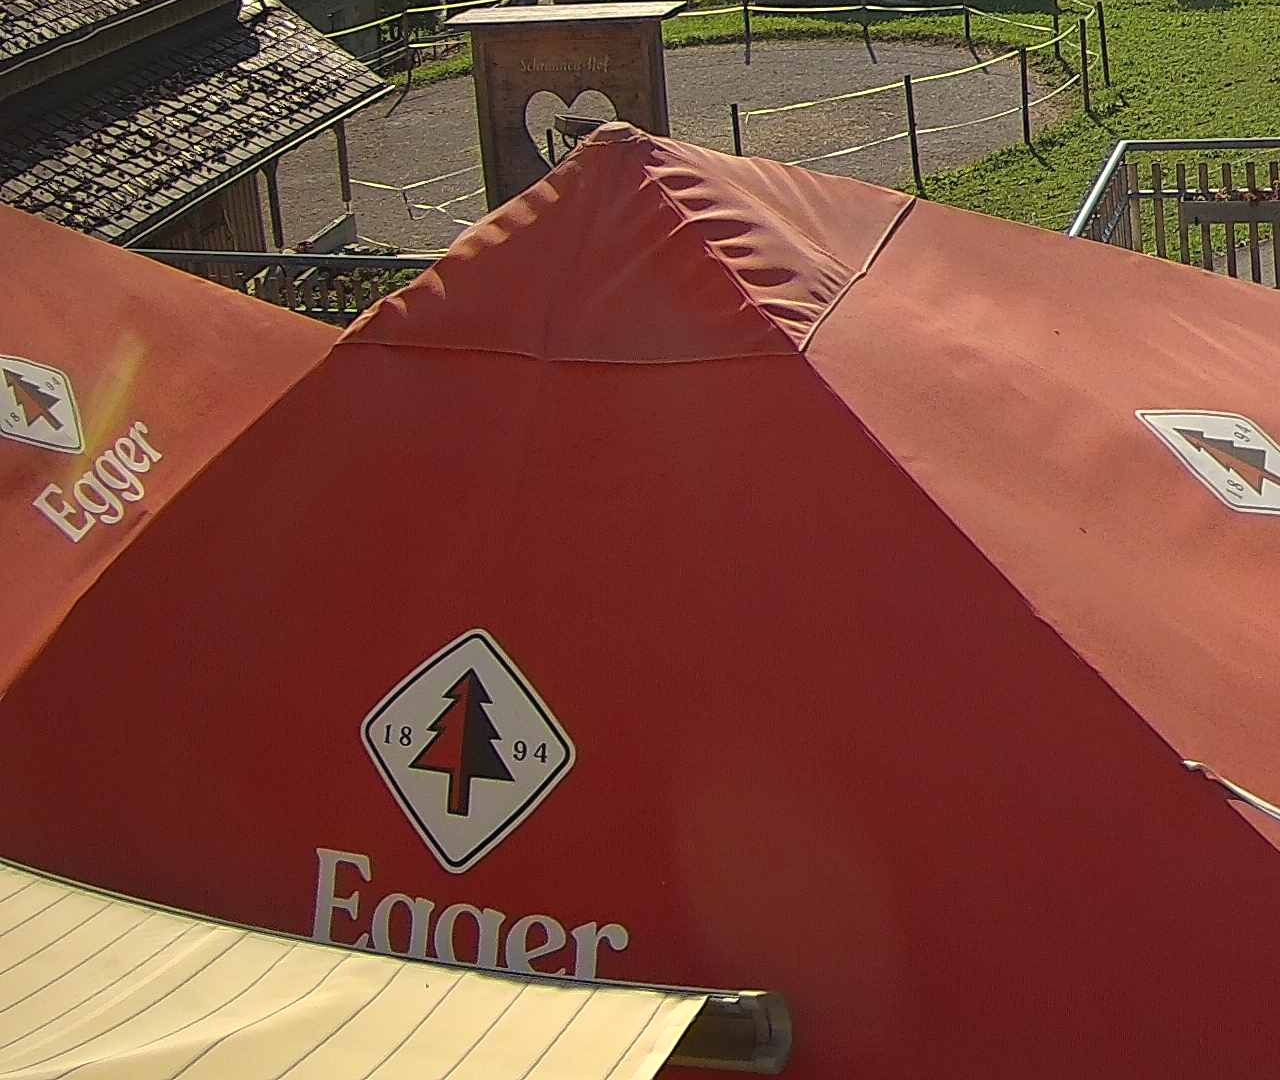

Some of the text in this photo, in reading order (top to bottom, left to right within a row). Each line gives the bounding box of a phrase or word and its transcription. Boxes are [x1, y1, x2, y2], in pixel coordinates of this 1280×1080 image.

[32, 421, 163, 543] Egger
[384, 724, 549, 763] 18 94
